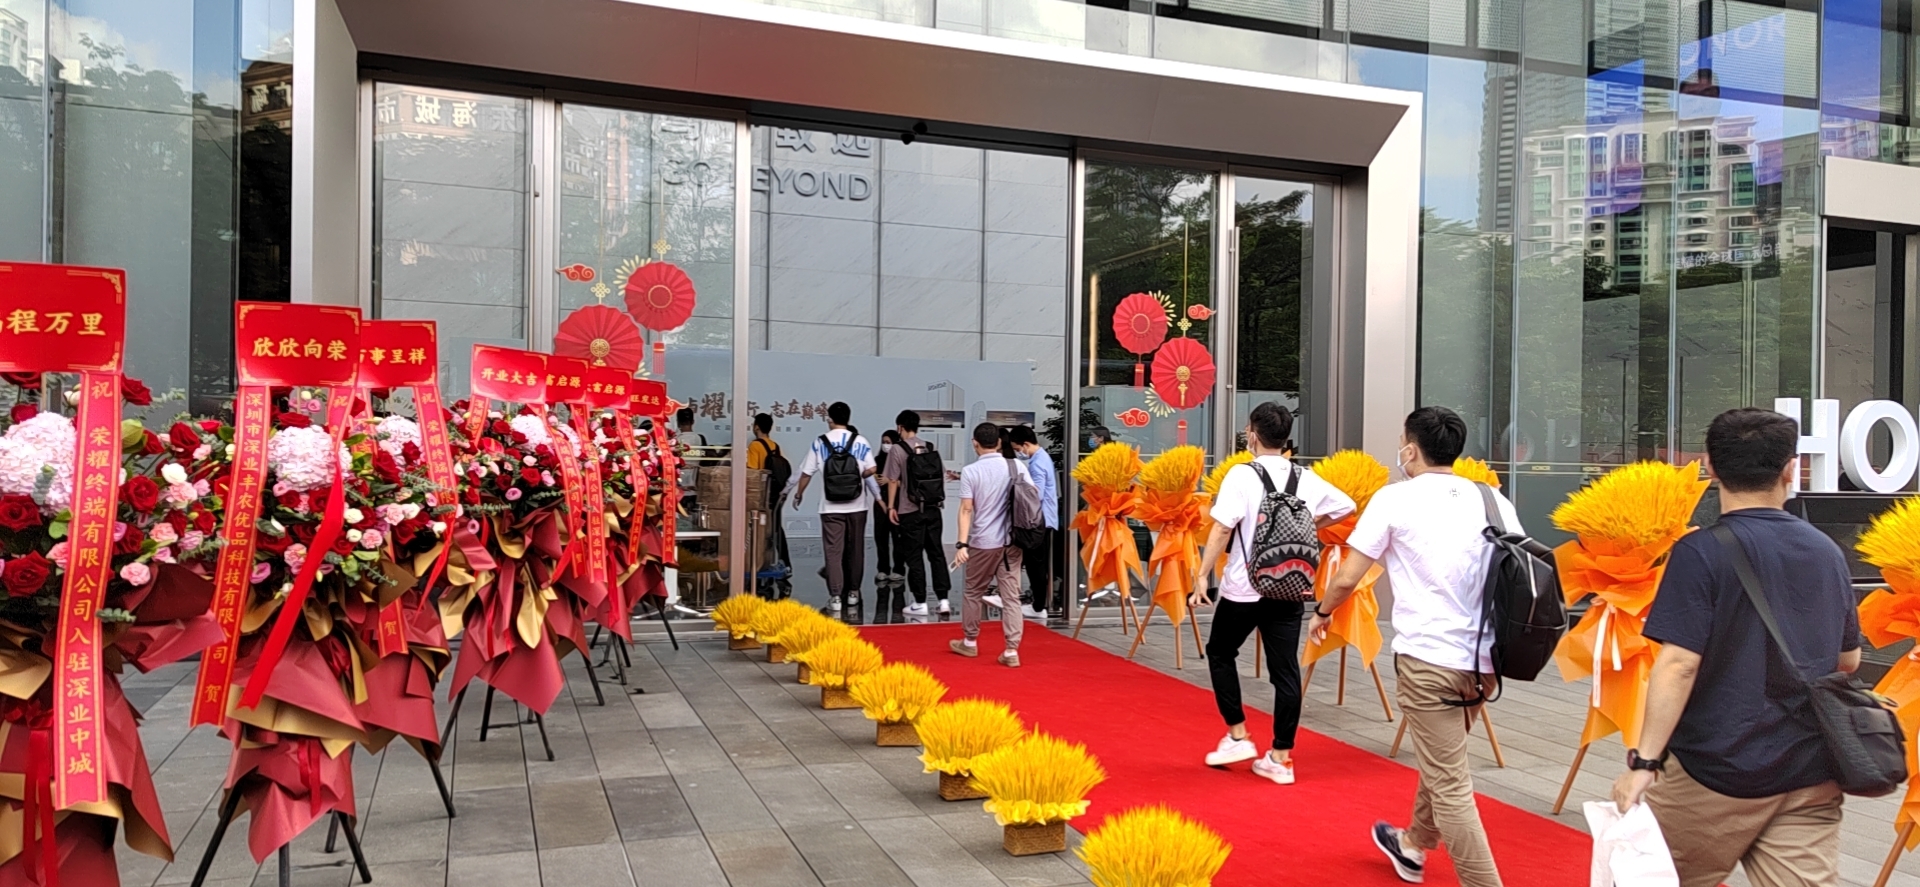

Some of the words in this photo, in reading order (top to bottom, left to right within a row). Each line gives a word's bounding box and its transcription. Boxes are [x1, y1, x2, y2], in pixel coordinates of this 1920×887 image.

[731, 162, 873, 202] EYOND
[0, 308, 106, 336] 程万里
[251, 336, 348, 361] 欣欣向荣
[90, 380, 113, 399] 祝
[481, 367, 538, 387] 开业大吉
[1775, 397, 1920, 494] HO
[66, 426, 112, 775] 荣耀终端有限公司入驻深业中城
